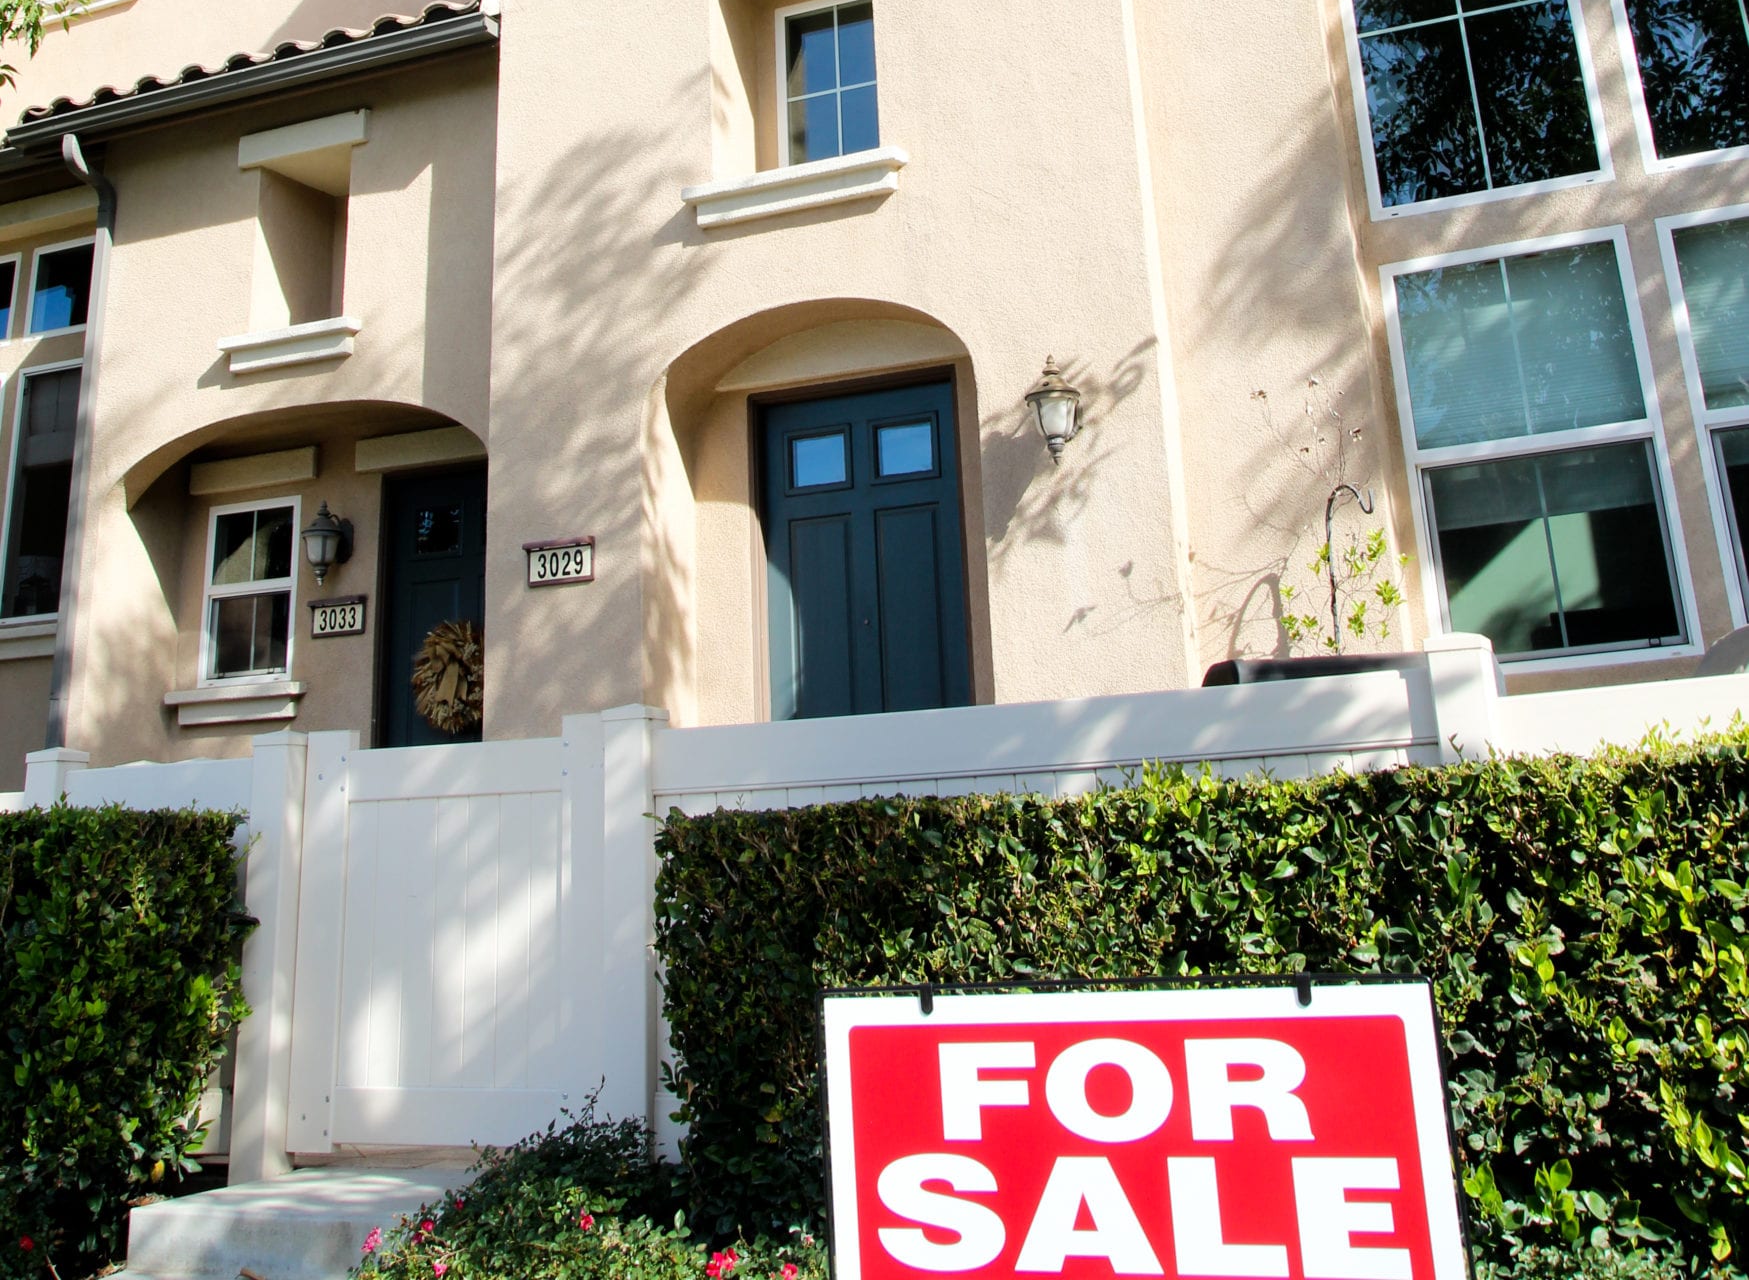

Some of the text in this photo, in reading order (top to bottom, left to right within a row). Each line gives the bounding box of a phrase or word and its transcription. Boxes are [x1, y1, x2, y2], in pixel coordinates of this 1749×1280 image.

[537, 549, 584, 579] 3029
[319, 607, 356, 631] 3033
[938, 1038, 1315, 1143] FOR
[876, 1152, 1413, 1280] SALE
